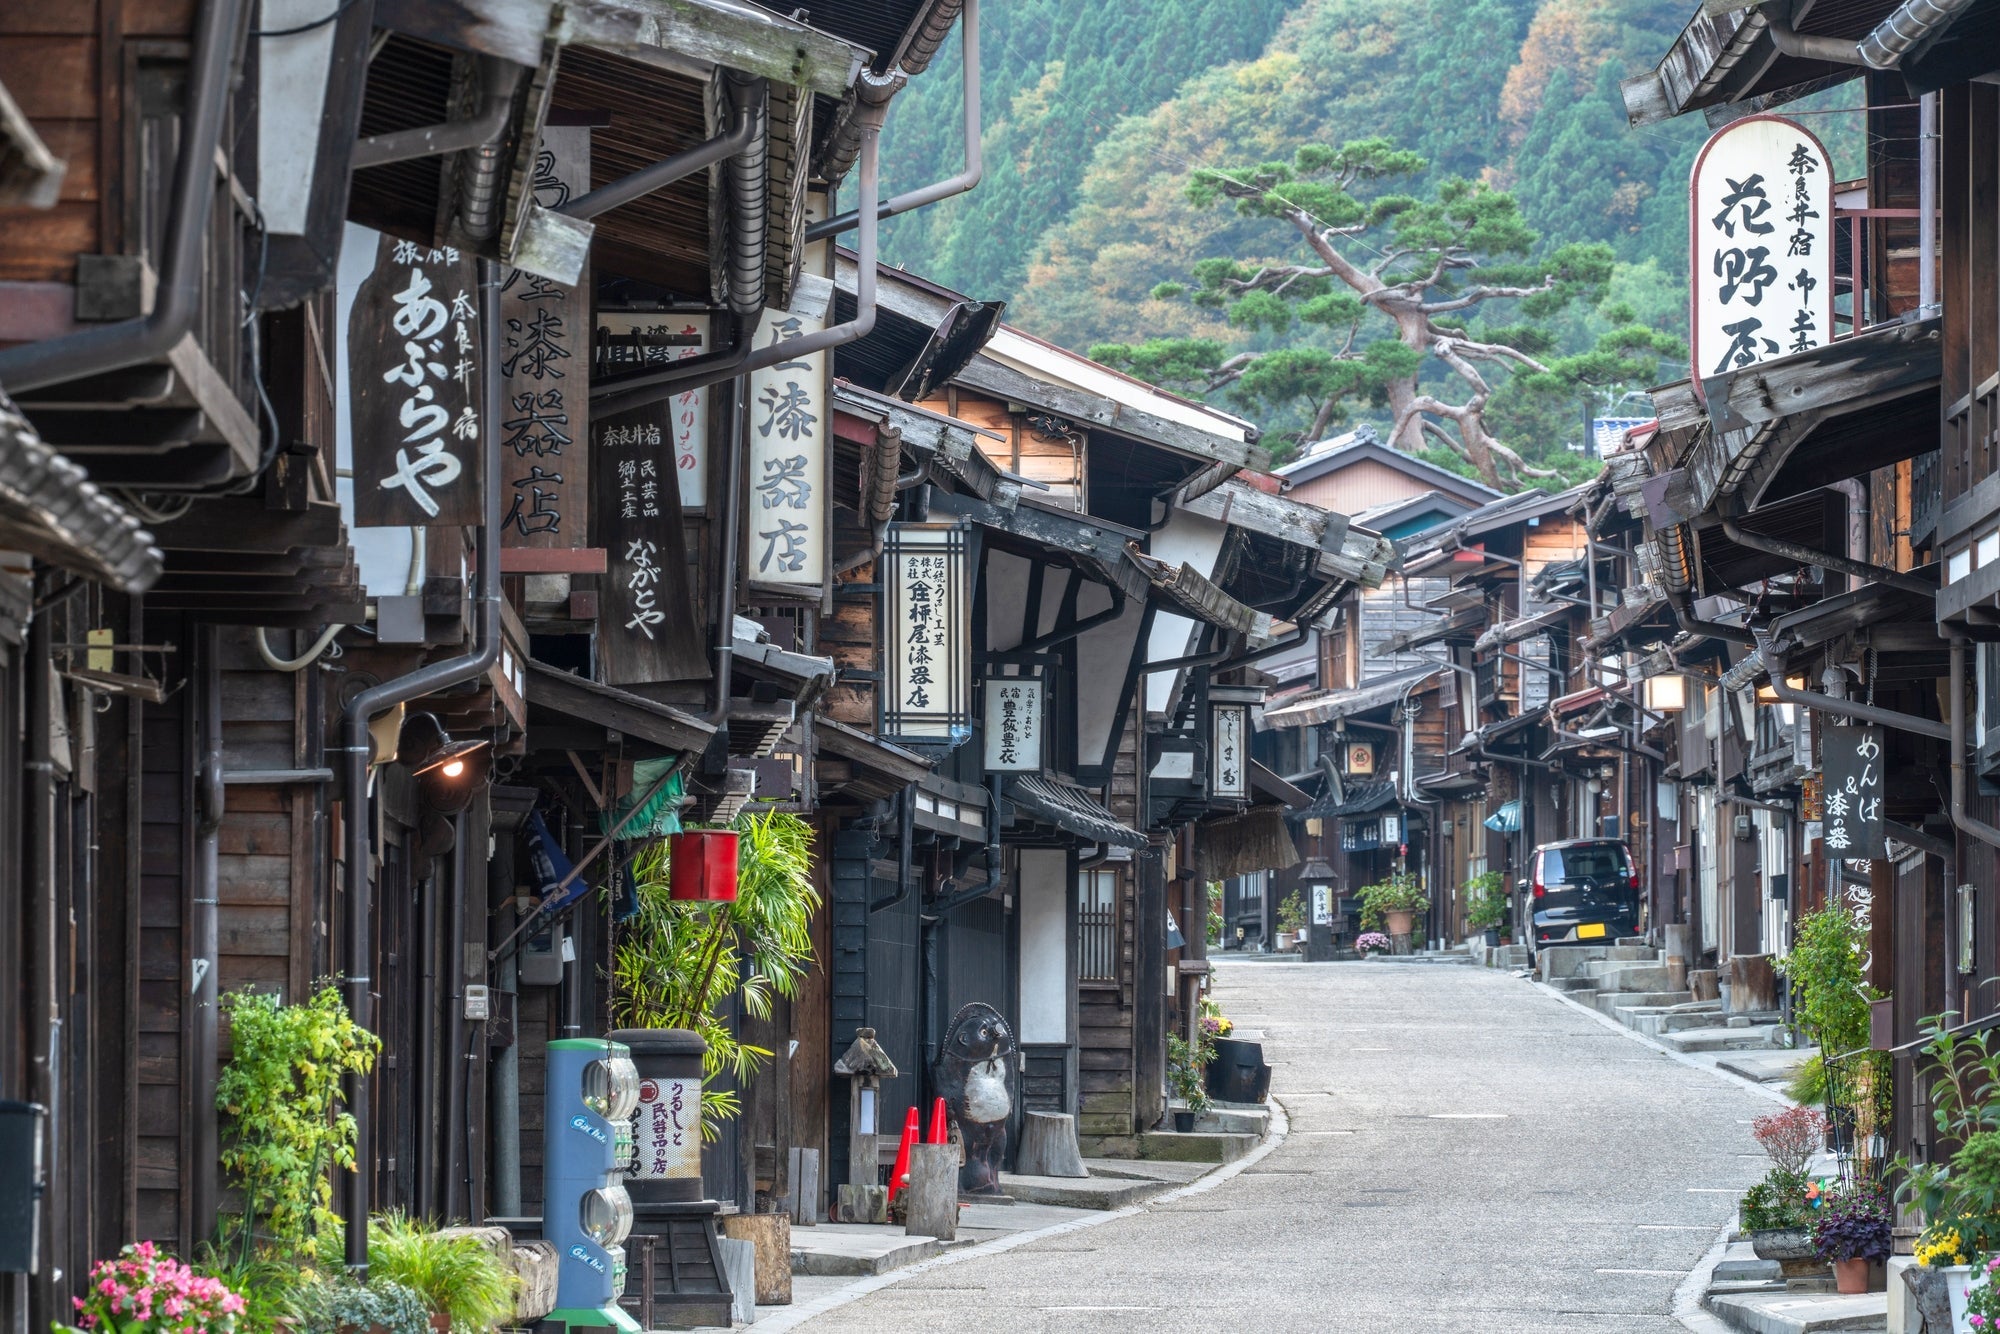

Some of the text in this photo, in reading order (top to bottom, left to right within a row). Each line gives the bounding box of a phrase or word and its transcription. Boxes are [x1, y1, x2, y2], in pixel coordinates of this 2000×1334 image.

[1786, 143, 1820, 257] 奈良井宿
[1712, 173, 1780, 374] 花野屋
[380, 267, 462, 517] あぶらや
[451, 289, 478, 440] 奈良井宿
[603, 424, 661, 446] 奈良井宿
[618, 460, 638, 518] 郷土土産
[640, 459, 660, 517] 民芸品
[625, 538, 666, 640] ながとや
[1825, 788, 1852, 849] 漆の器
[1856, 733, 1880, 822] めんぱ
[670, 1082, 683, 1146] うるしと
